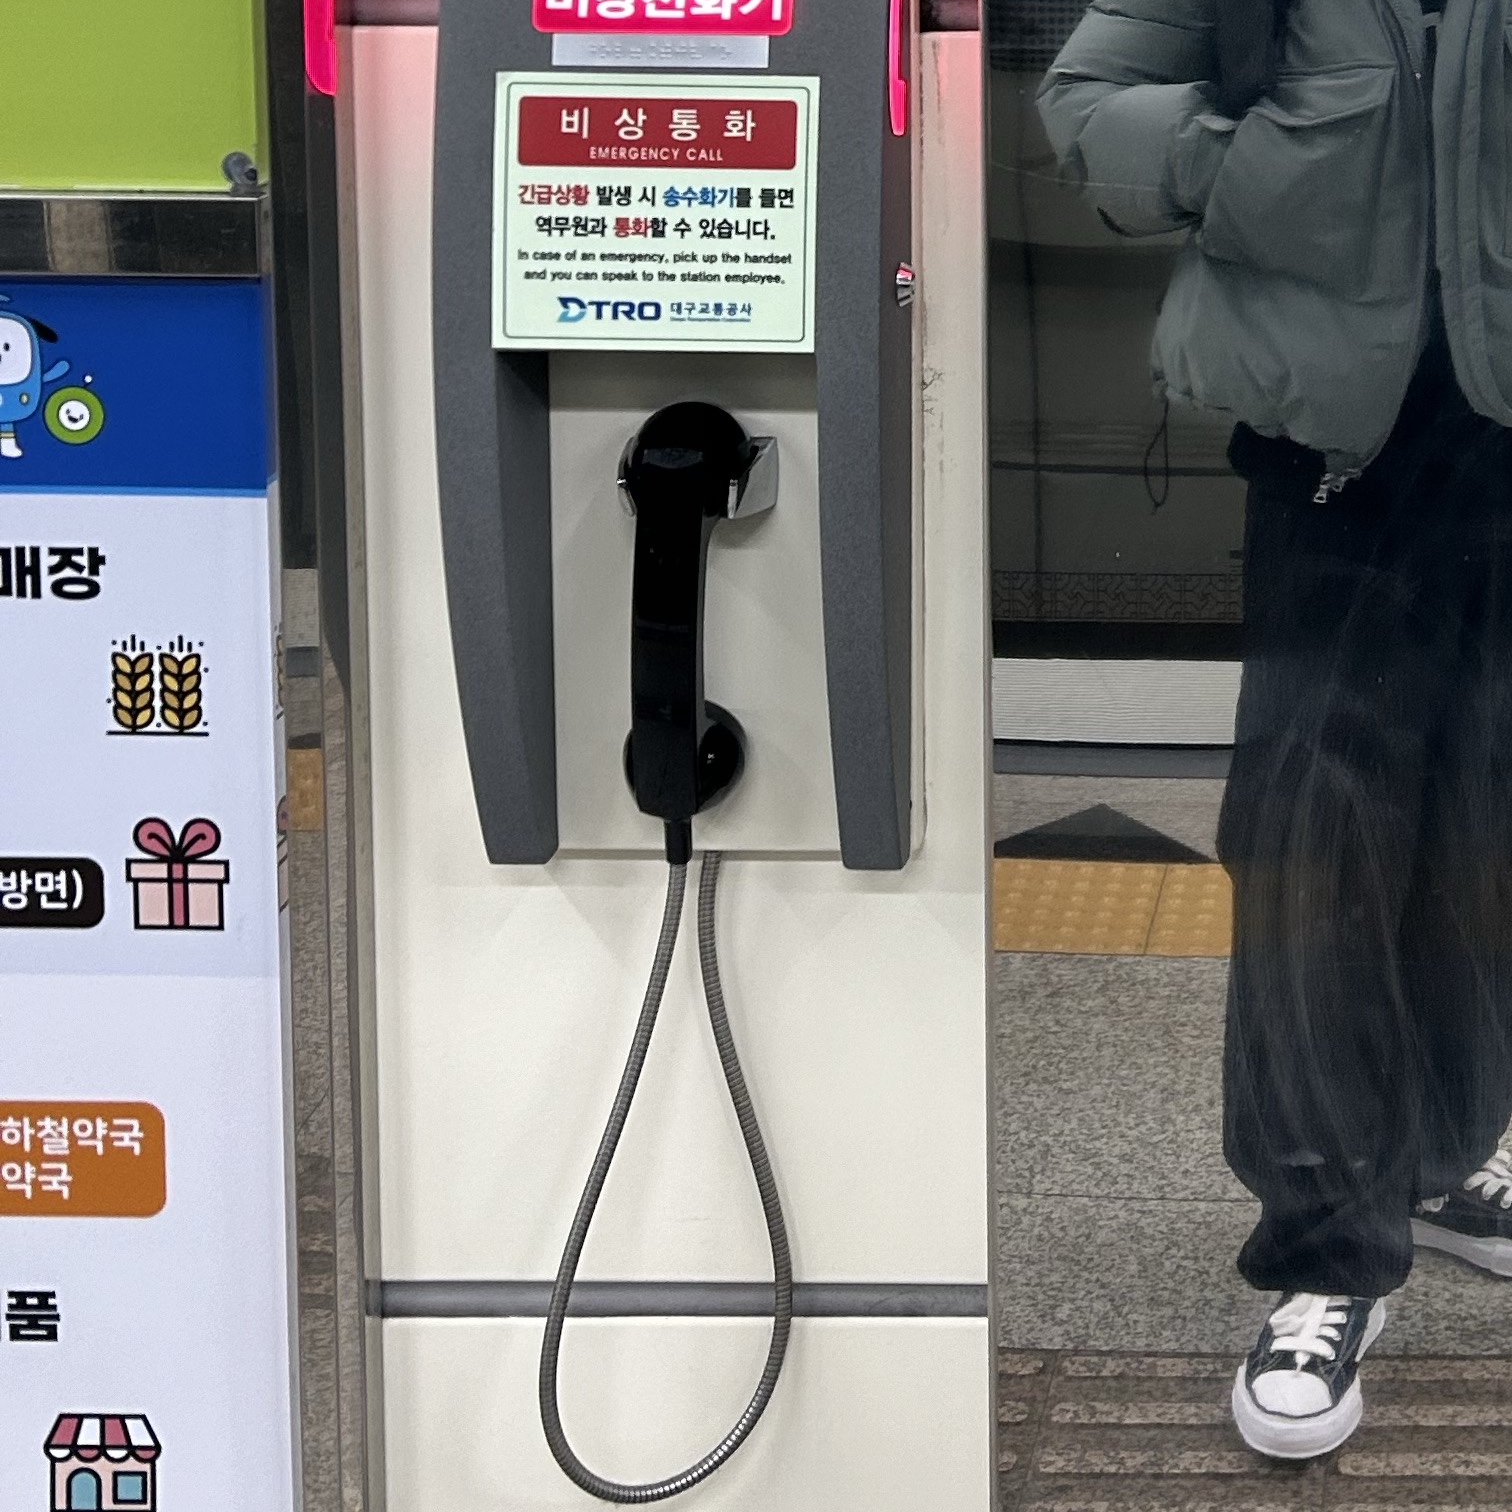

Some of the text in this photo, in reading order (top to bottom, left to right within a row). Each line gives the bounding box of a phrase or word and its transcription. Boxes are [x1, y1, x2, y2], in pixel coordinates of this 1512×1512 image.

[589, 147, 723, 162] EMERGENCY CALL
[518, 184, 794, 208] 긴급상황 발생 시 송수화기를 들면
[535, 216, 776, 240] 역무원과 통화할 수 있습니다.
[517, 249, 529, 261] In
[532, 251, 561, 261] case
[565, 250, 577, 261] of
[581, 253, 596, 262] an
[673, 252, 698, 264] pick
[702, 254, 718, 264] up
[721, 252, 740, 263] the
[744, 253, 792, 265] handset
[524, 270, 785, 284] and you can speak to the station employee.
[557, 297, 662, 323] DTRO
[0, 545, 107, 600] 매장
[0, 869, 83, 910] 방면)
[0, 1116, 144, 1156] 하철약국
[1, 1161, 73, 1200] 약국
[0, 1290, 61, 1342] 품
